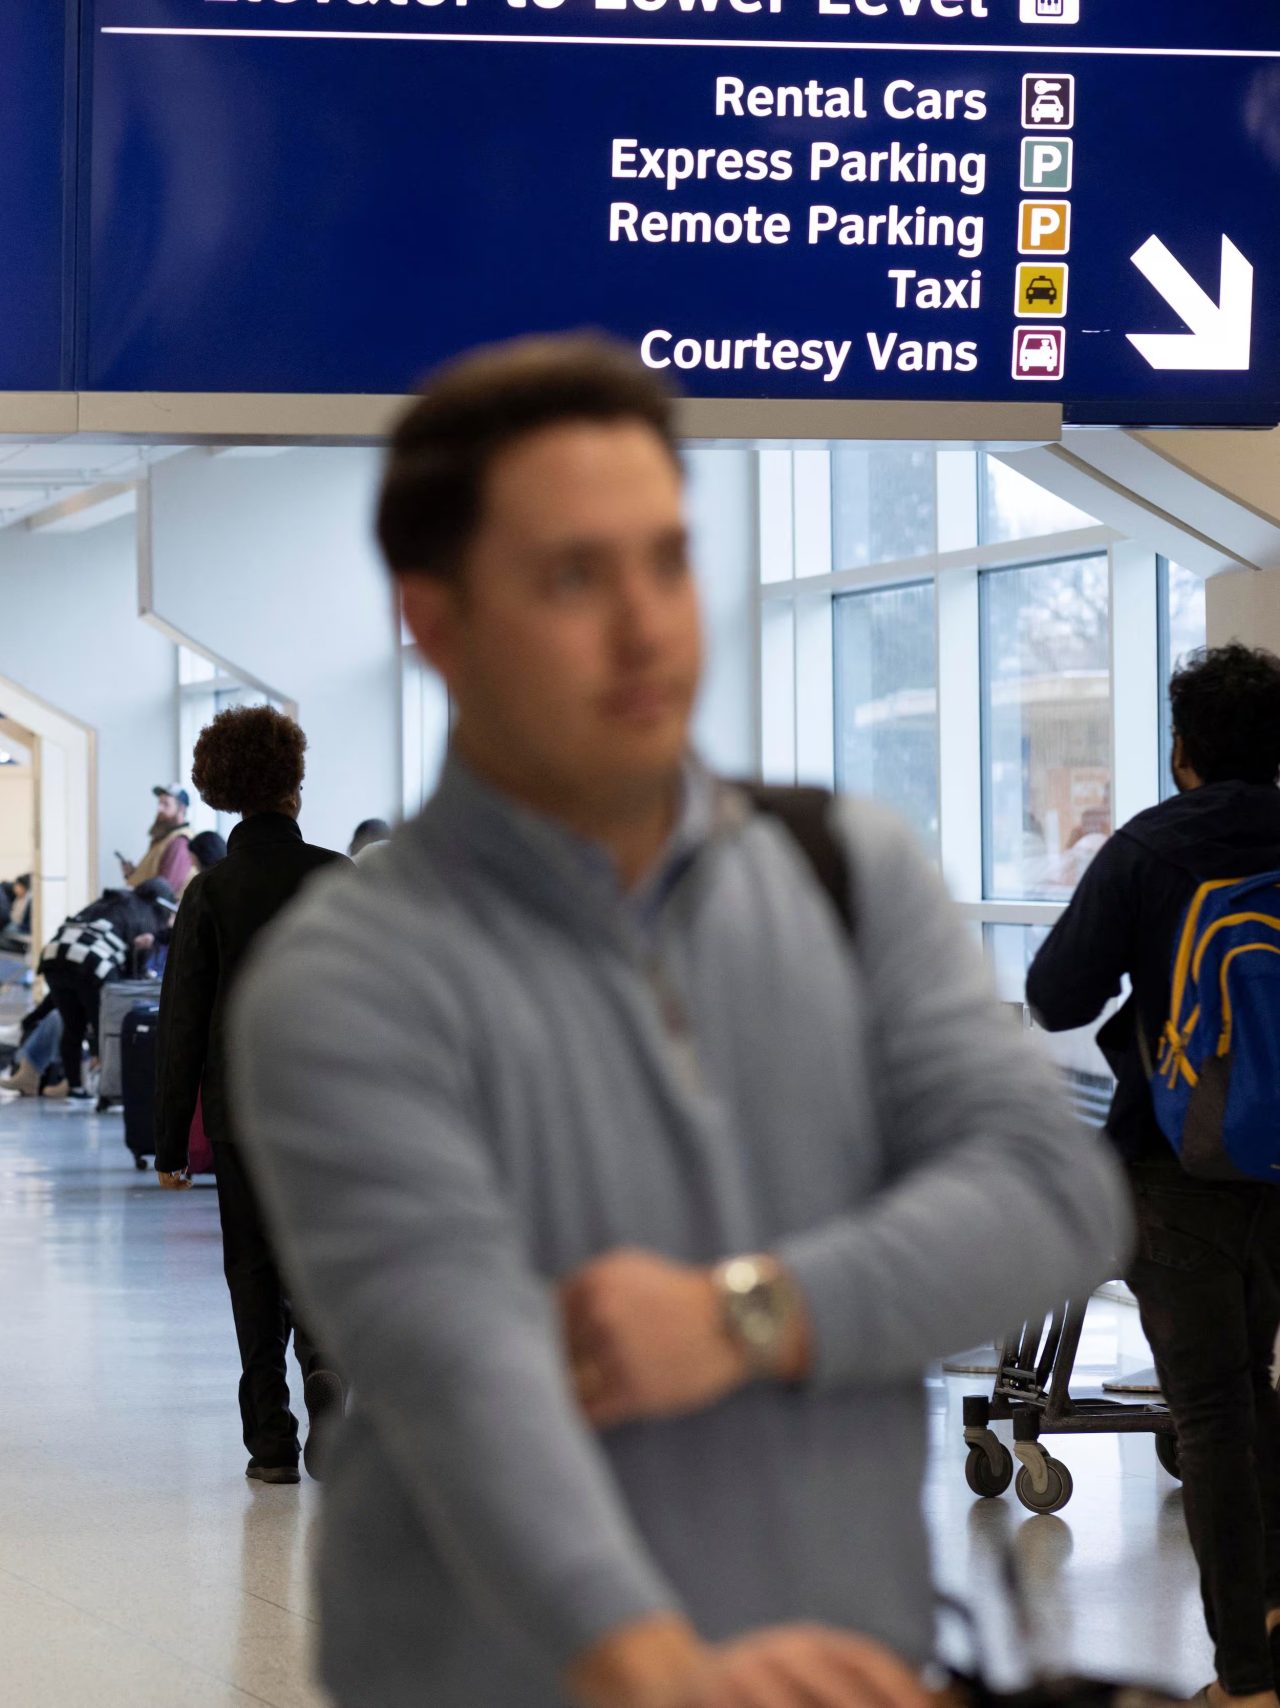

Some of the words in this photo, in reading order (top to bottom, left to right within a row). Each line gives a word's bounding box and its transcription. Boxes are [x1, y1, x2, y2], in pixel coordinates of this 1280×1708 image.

[715, 75, 868, 119] Rental
[883, 79, 987, 121] Cars
[611, 138, 793, 191] Express
[810, 141, 986, 196] Parking
[1032, 144, 1063, 184] P
[609, 201, 791, 245] Remote
[808, 204, 984, 257] Parking
[1030, 207, 1061, 247] P
[887, 269, 982, 309] Taxi
[640, 329, 852, 382] Courtesy
[866, 331, 978, 372] Vans
